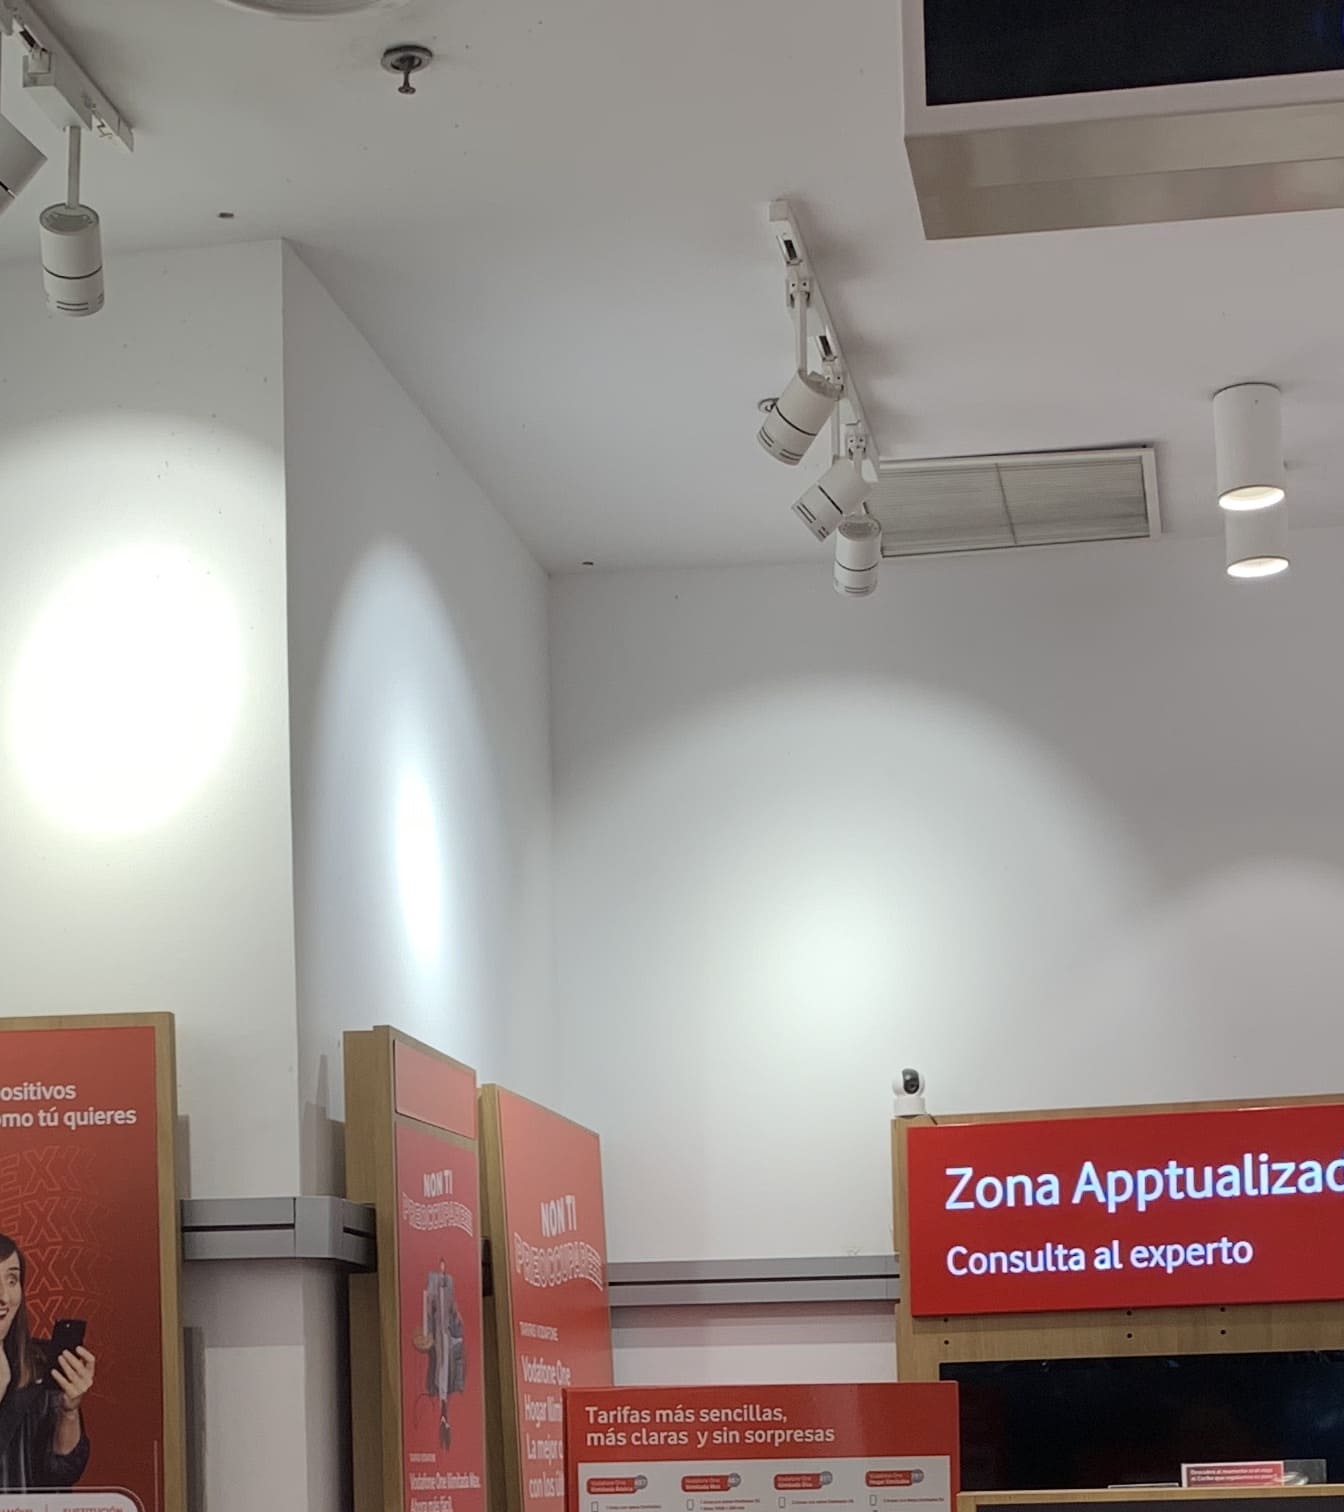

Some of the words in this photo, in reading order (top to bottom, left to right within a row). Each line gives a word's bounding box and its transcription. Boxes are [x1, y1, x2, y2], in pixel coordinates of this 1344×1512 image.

[38, 1106, 57, 1127] tú
[63, 1106, 137, 1130] quieres
[423, 1171, 443, 1198] NON
[444, 1169, 453, 1194] TI
[945, 1167, 1060, 1210] Zona
[540, 1197, 565, 1237] NON
[566, 1195, 577, 1231] TI
[946, 1242, 1085, 1276] Consulta
[1093, 1240, 1123, 1270] al
[1130, 1236, 1254, 1274] experto
[521, 1355, 556, 1385] Vodafone
[585, 1405, 651, 1424] Tarifas
[655, 1404, 694, 1423] más
[699, 1404, 787, 1423] sencillas,
[586, 1427, 627, 1446] más
[631, 1427, 689, 1445] claras
[696, 1430, 708, 1448] y
[712, 1427, 740, 1444] sin
[744, 1428, 835, 1447] sorpresas
